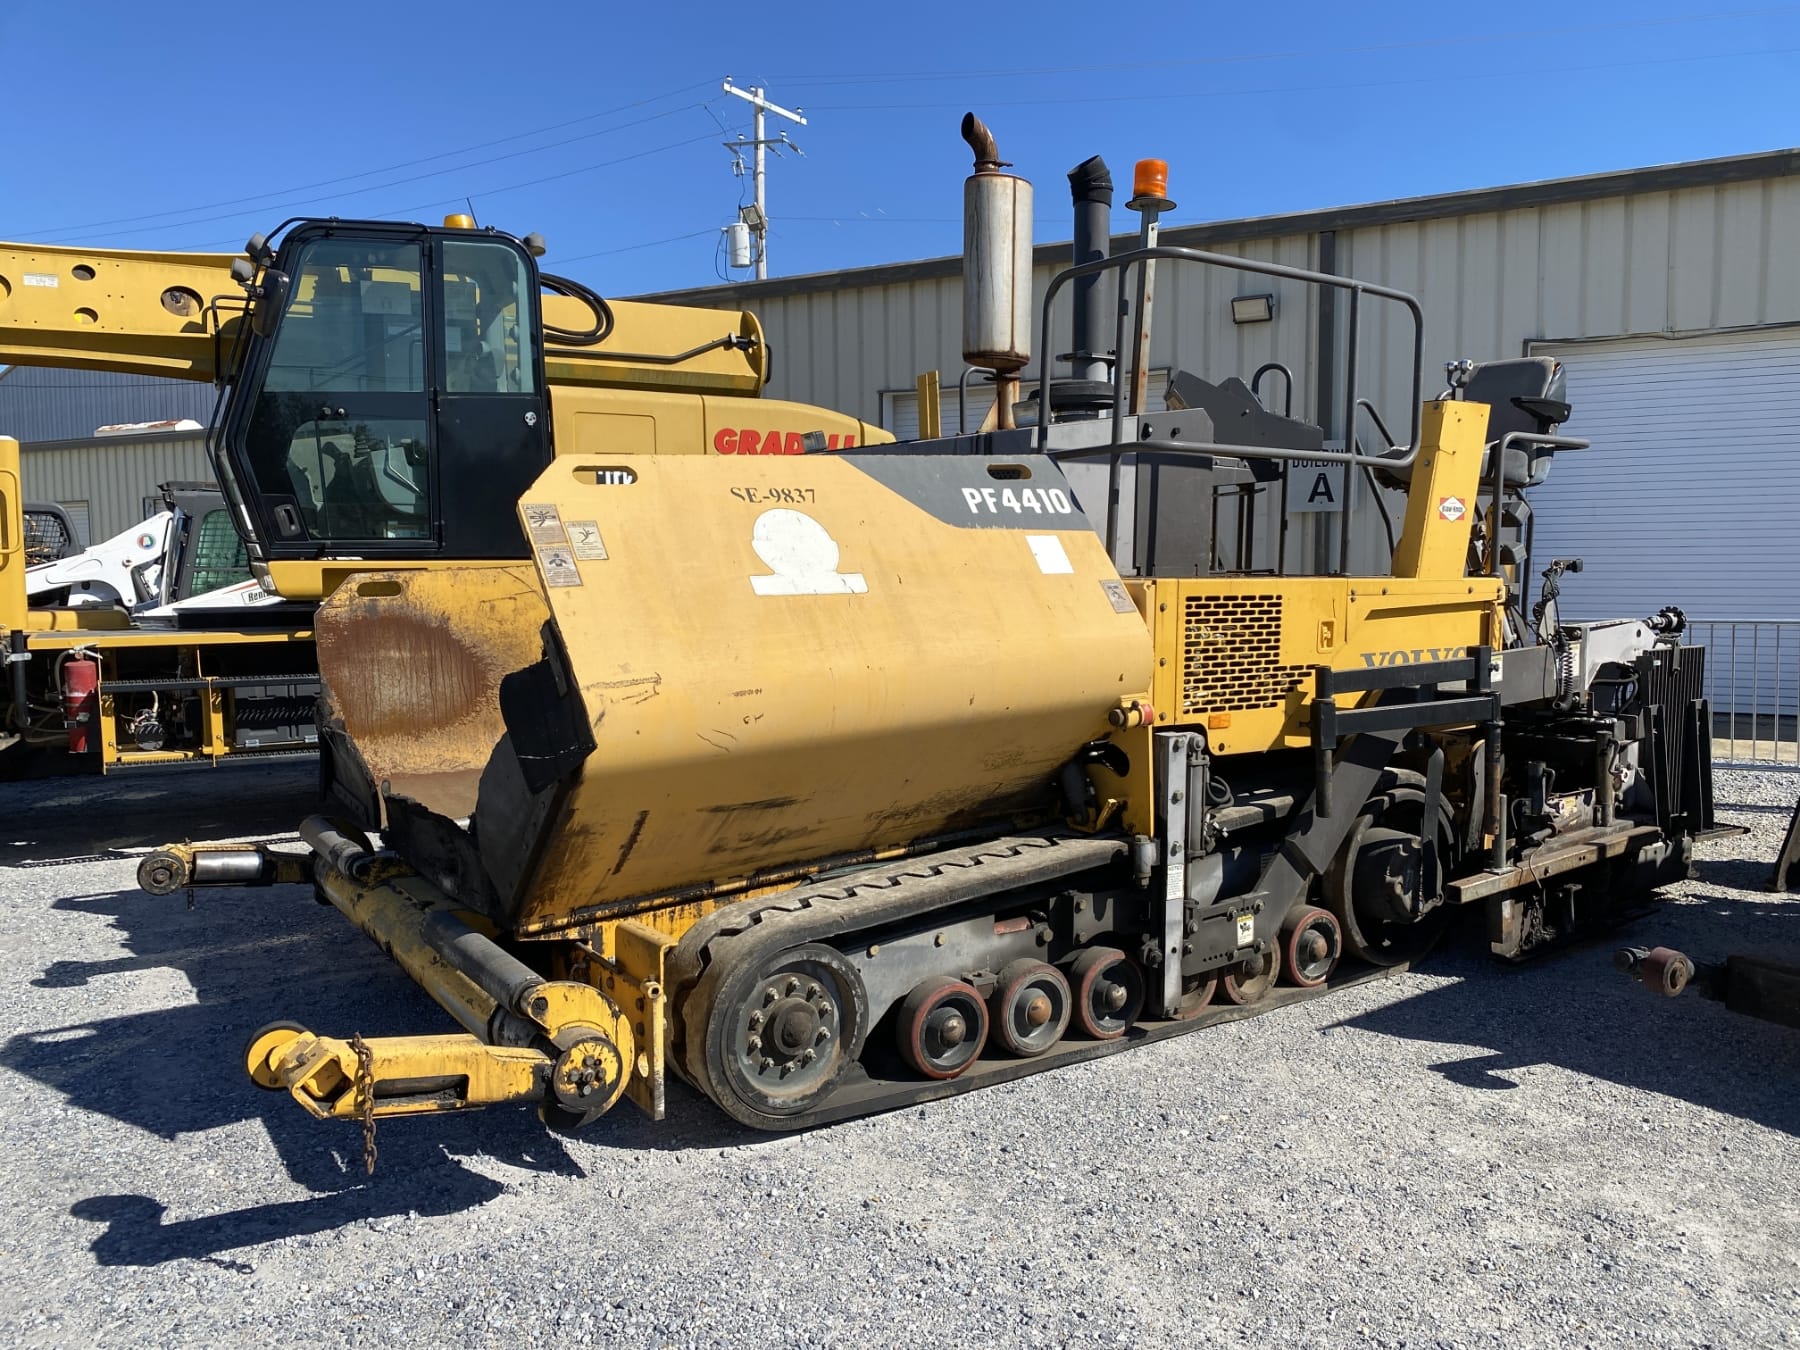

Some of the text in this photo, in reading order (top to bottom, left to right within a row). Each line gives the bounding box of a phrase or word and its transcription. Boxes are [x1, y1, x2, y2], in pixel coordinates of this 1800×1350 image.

[714, 428, 855, 455] GRADLL
[730, 487, 815, 504] SE-9837
[1307, 472, 1335, 503] A
